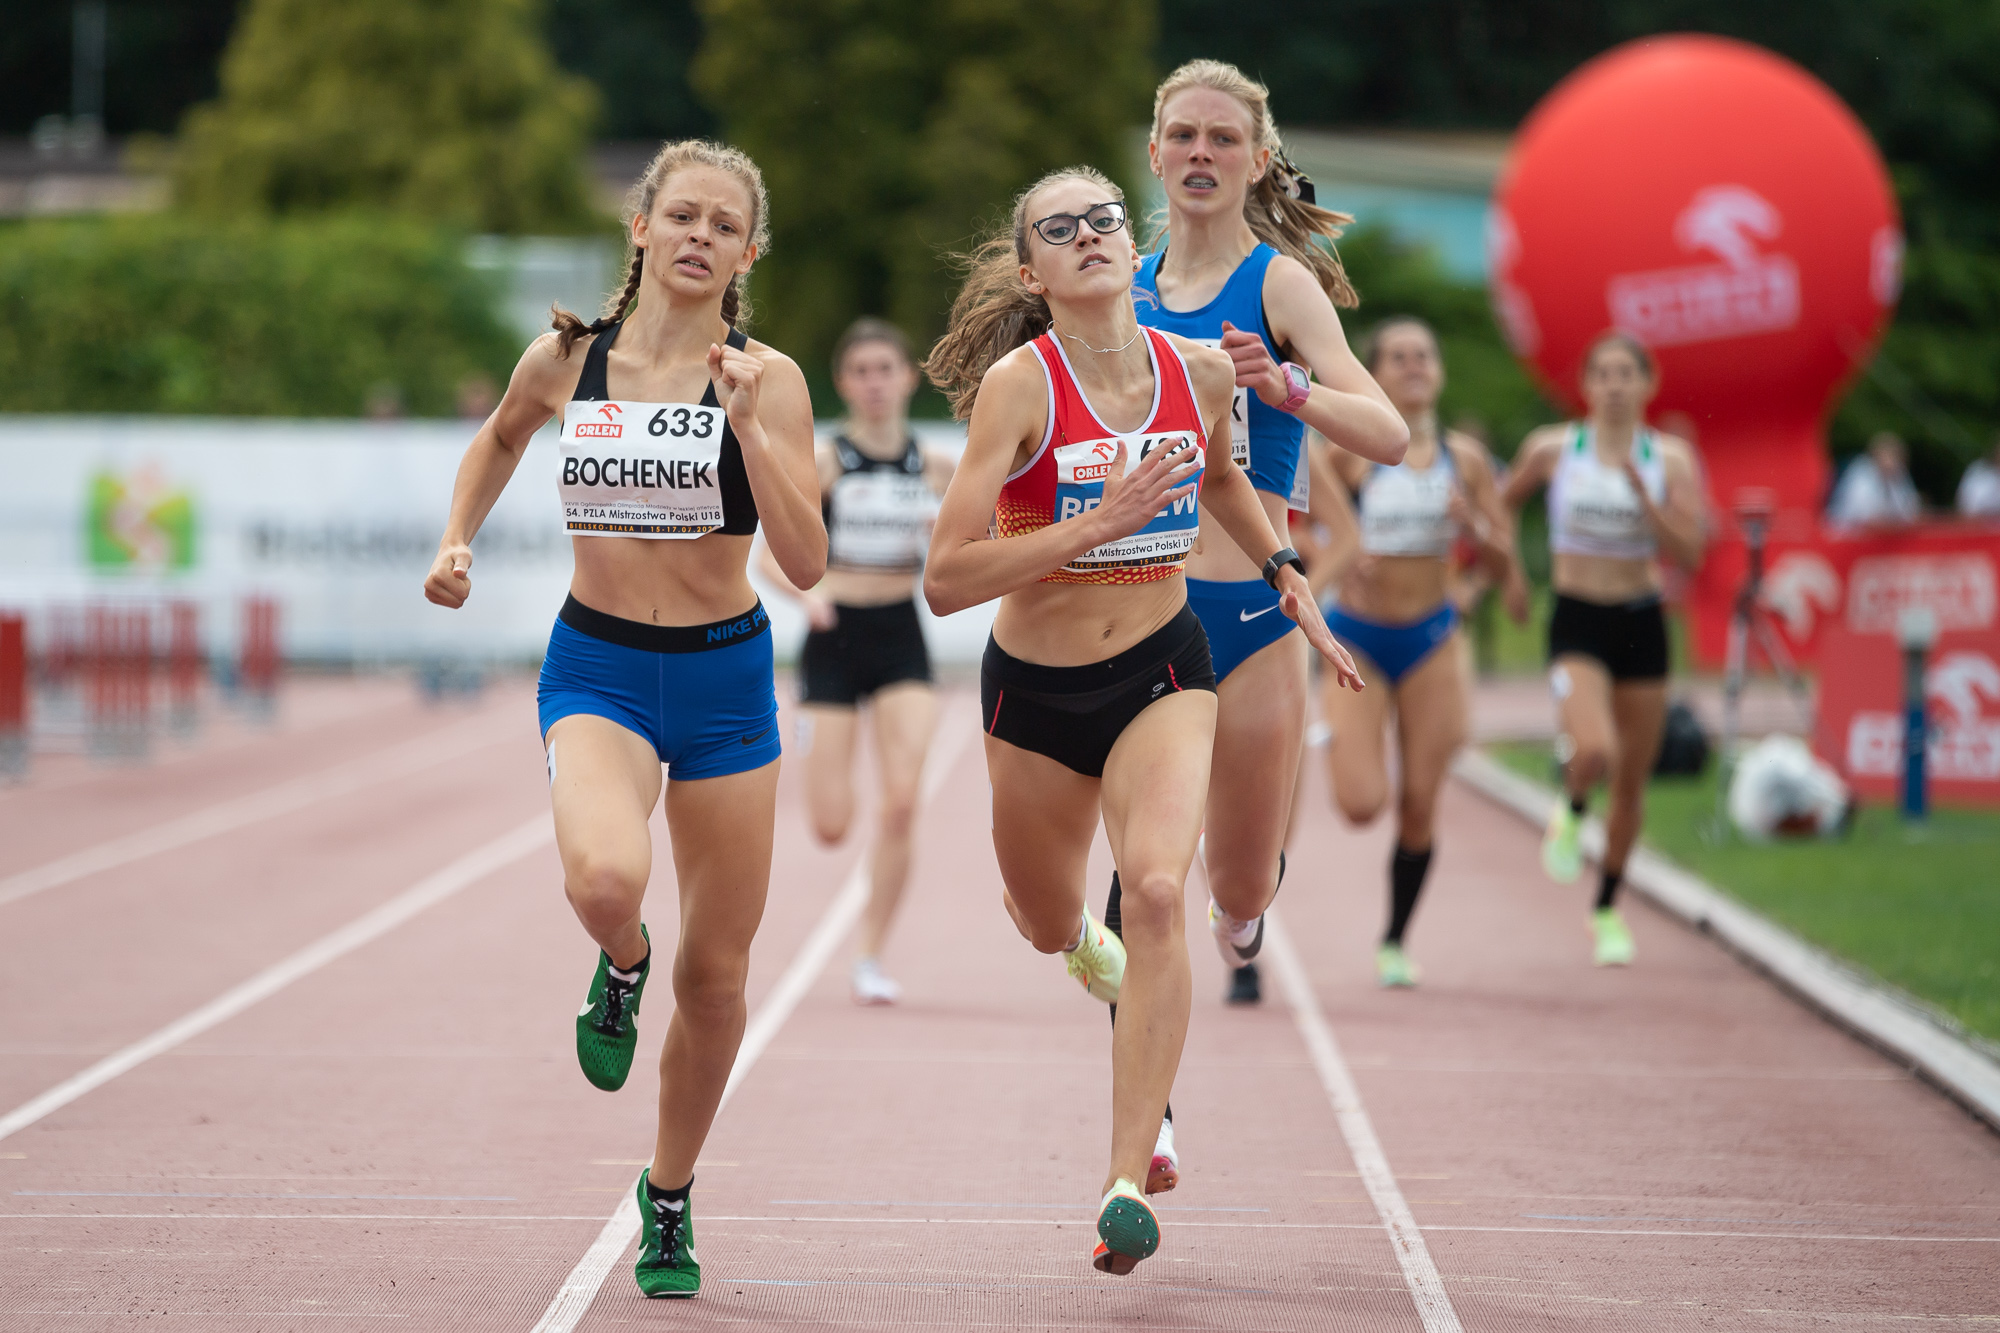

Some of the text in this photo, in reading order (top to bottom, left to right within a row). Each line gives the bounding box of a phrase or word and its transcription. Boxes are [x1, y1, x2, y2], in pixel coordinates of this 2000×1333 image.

[577, 425, 620, 437] ORLEN
[648, 408, 714, 439] 633
[563, 457, 714, 489] BOCHENEK
[566, 508, 721, 522] 54. PZLA Mistrzostwa Polski U18
[569, 522, 635, 532] BIELSKO-BIAŁA
[1098, 545, 1153, 557] Mistrzostwa
[1155, 539, 1181, 551] Polski
[706, 618, 752, 643] NIKE
